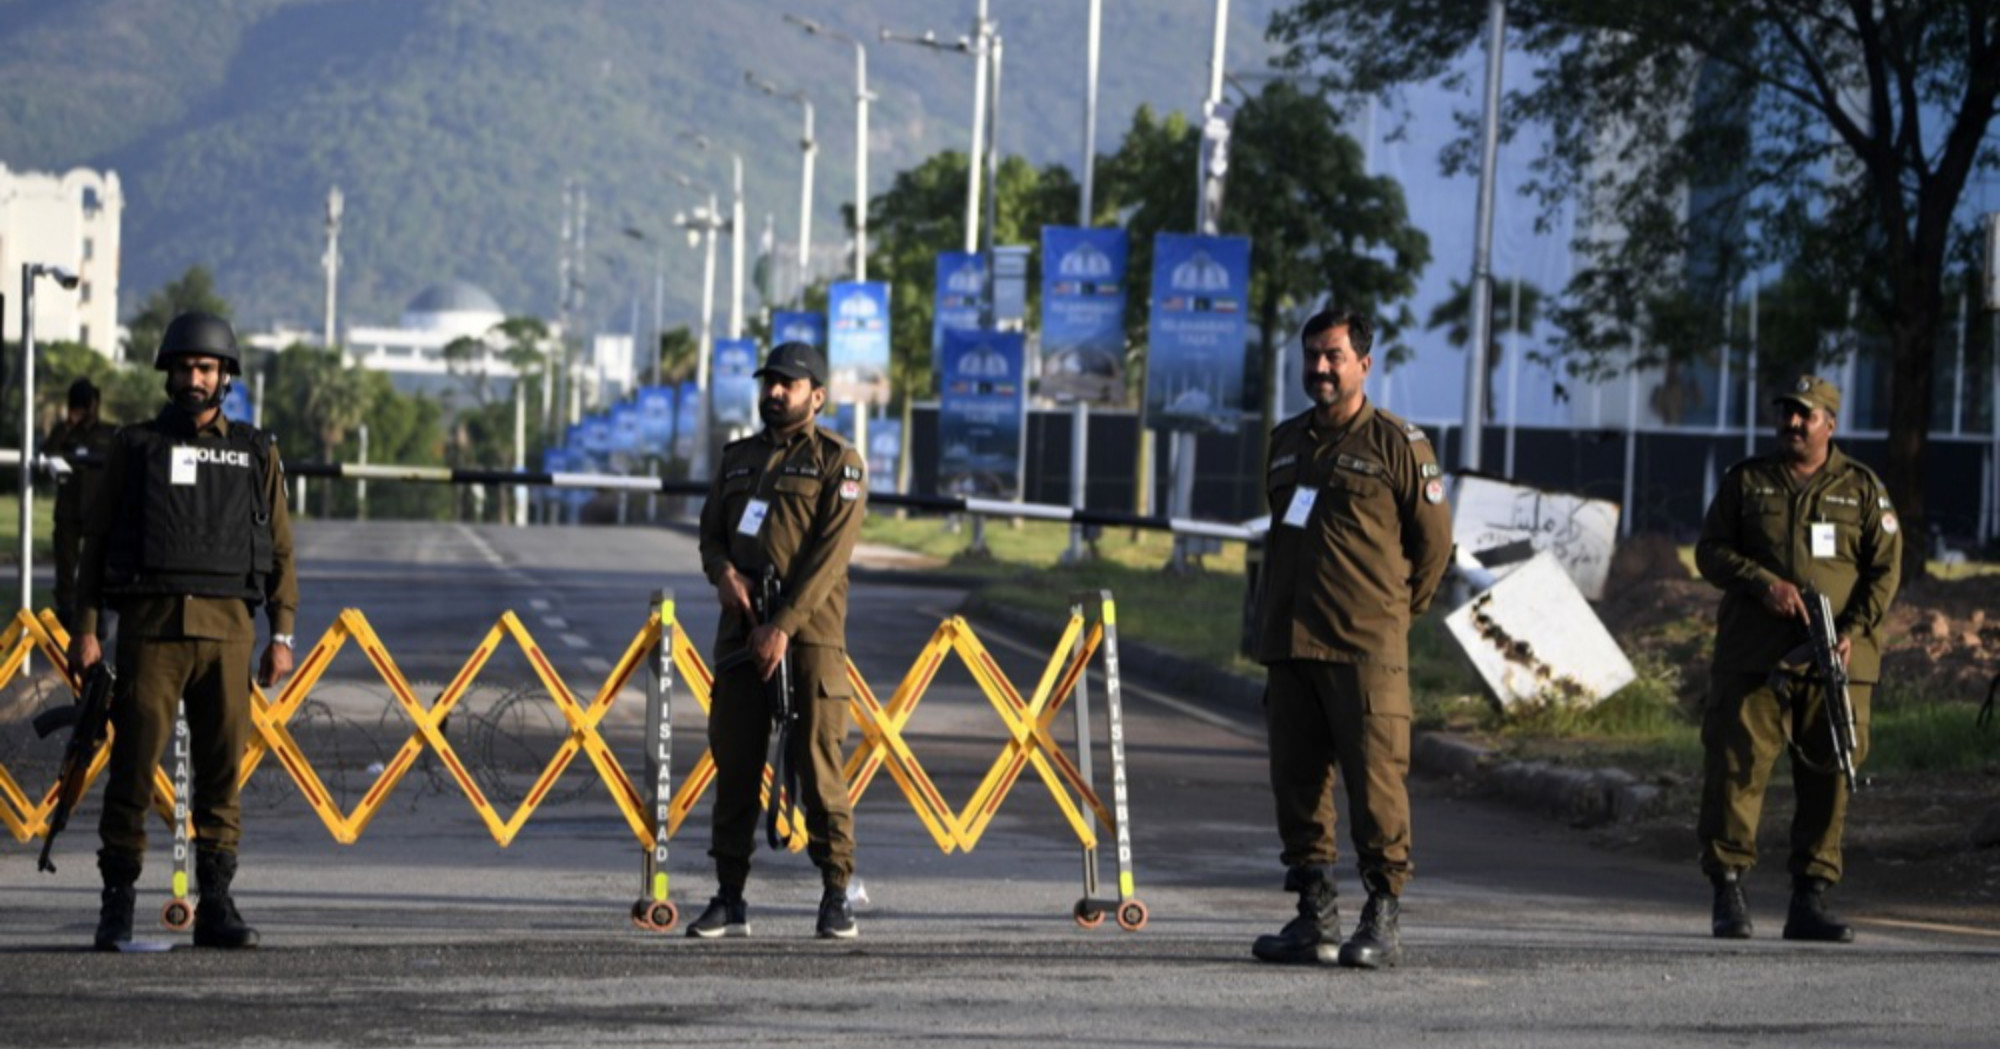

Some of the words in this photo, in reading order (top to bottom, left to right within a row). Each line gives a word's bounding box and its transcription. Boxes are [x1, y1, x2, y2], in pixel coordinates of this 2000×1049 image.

[196, 447, 250, 468] OLICE
[659, 636, 673, 693] ITP
[1106, 637, 1120, 695] ITP
[655, 703, 671, 862] ISLAMBAD
[1112, 704, 1132, 862] ISLAMBAD
